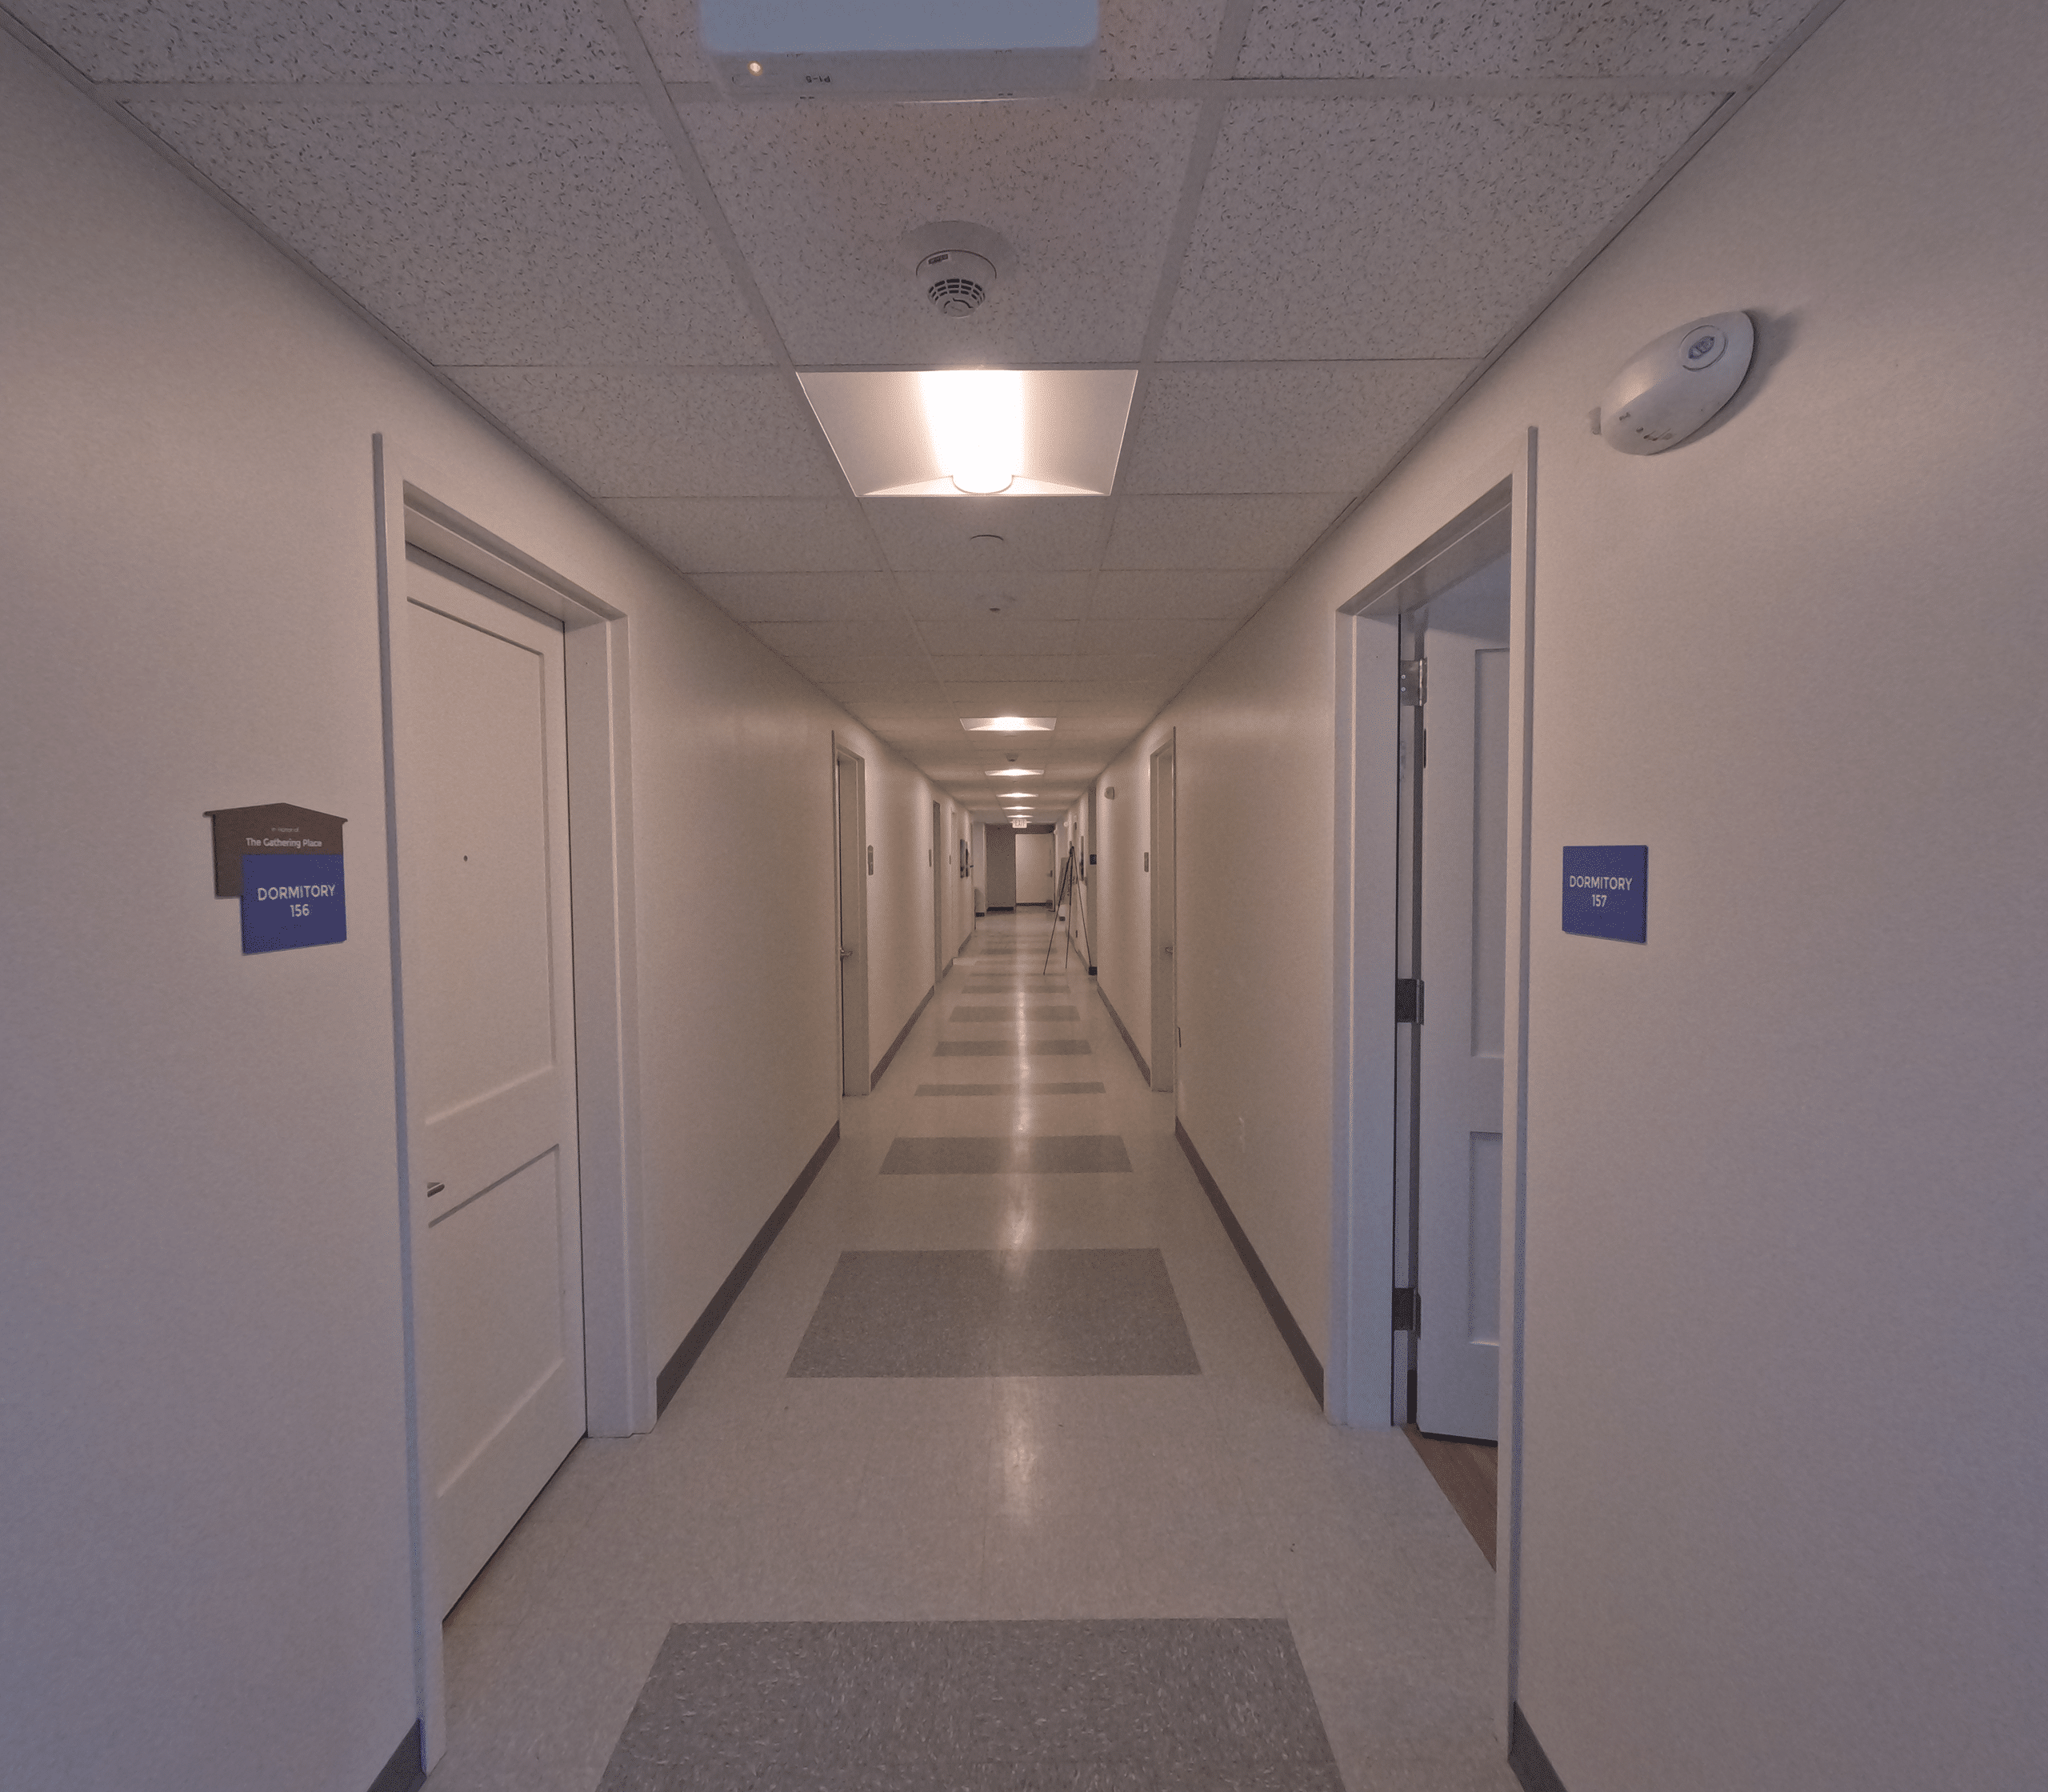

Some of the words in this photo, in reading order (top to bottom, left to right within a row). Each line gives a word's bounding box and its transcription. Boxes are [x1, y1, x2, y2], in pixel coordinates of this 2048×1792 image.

[246, 838, 262, 846] The
[263, 838, 302, 849] Gathering
[302, 838, 322, 847] Place
[1569, 875, 1633, 890] DORMITORY
[257, 884, 335, 901] DORMITORY
[1591, 894, 1607, 907] 157
[290, 903, 310, 918] 156
